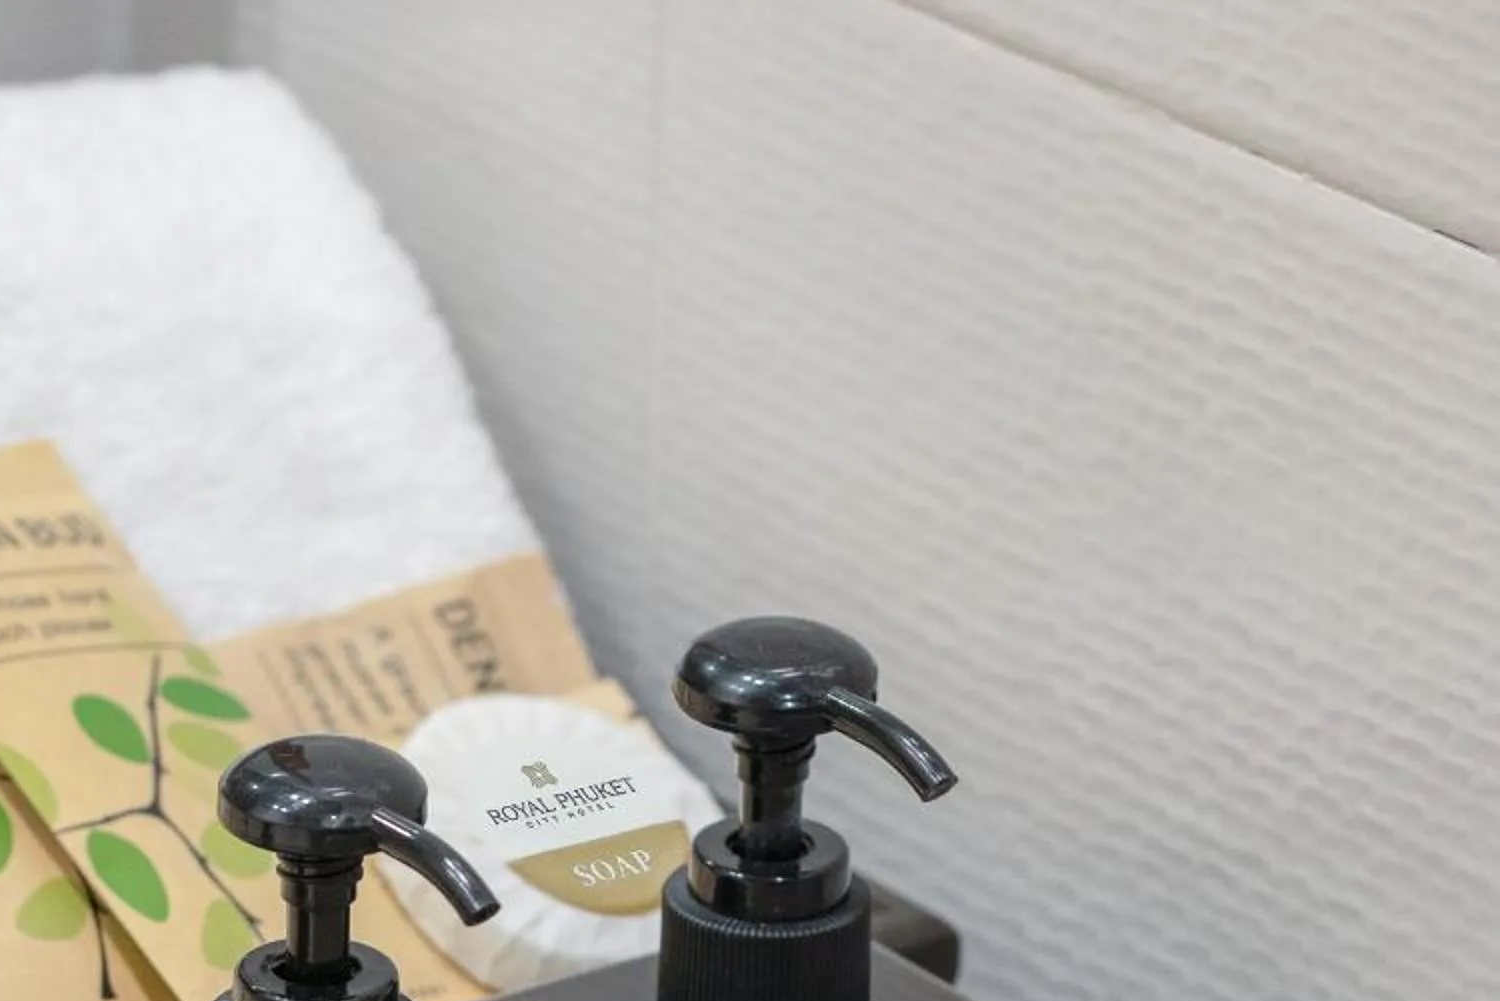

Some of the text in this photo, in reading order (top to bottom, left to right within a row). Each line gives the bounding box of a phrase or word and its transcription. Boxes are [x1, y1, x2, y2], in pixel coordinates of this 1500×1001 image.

[486, 776, 640, 826] ROYAL PHUKET
[525, 814, 560, 830] CITY
[572, 848, 652, 888] SOAP
